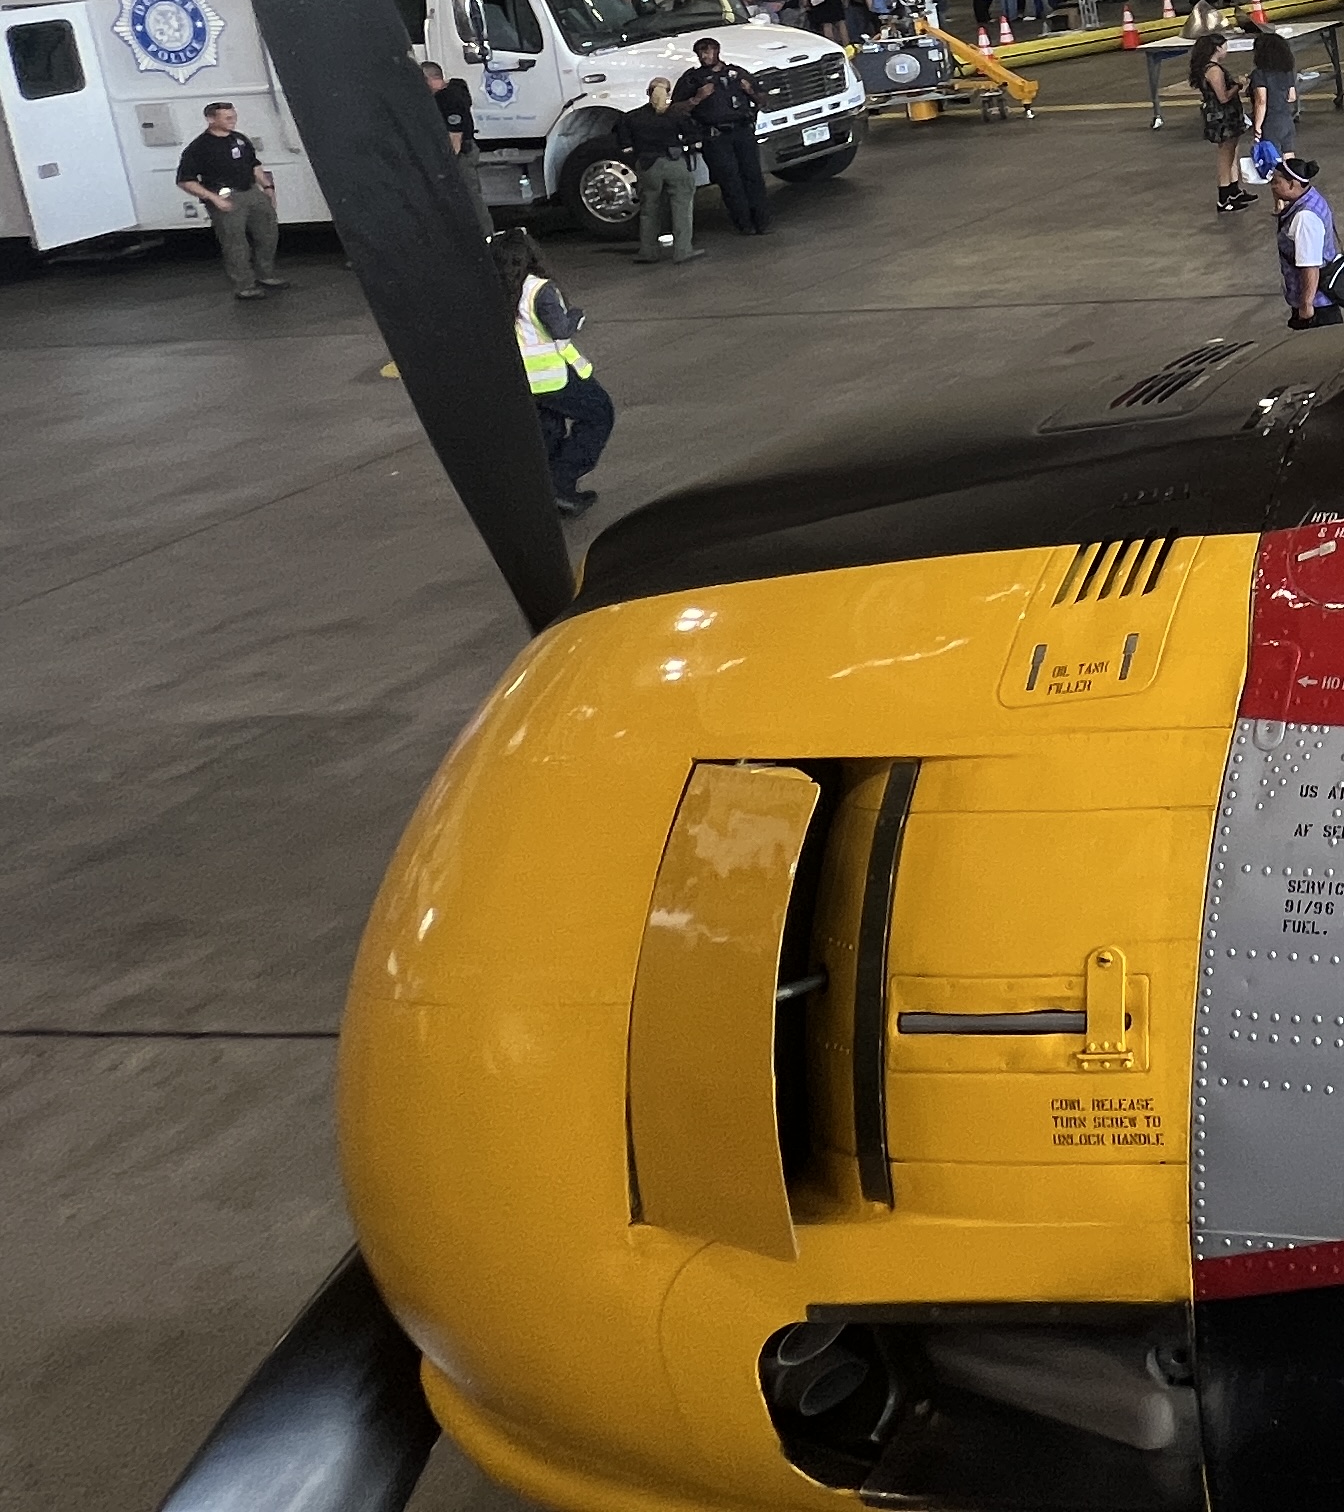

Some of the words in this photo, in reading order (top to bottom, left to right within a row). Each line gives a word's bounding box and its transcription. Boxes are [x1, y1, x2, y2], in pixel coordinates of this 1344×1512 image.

[147, 39, 201, 64] POLICE
[1317, 527, 1328, 538] &
[1052, 664, 1070, 678] OIL
[1078, 660, 1110, 675] TANK
[1047, 679, 1092, 696] FILLER
[1299, 784, 1319, 799] US
[1293, 823, 1314, 838] AF
[1284, 899, 1335, 916] 91/96
[1282, 919, 1328, 936] FUEL.
[1051, 1098, 1085, 1111] COWL
[1091, 1098, 1155, 1112] RELEASE
[1052, 1115, 1087, 1128] TURN
[1093, 1115, 1138, 1128] SCREW
[1144, 1115, 1161, 1128] TO
[1052, 1133, 1106, 1146] UNLOCK
[1111, 1133, 1165, 1146] HANDLE
